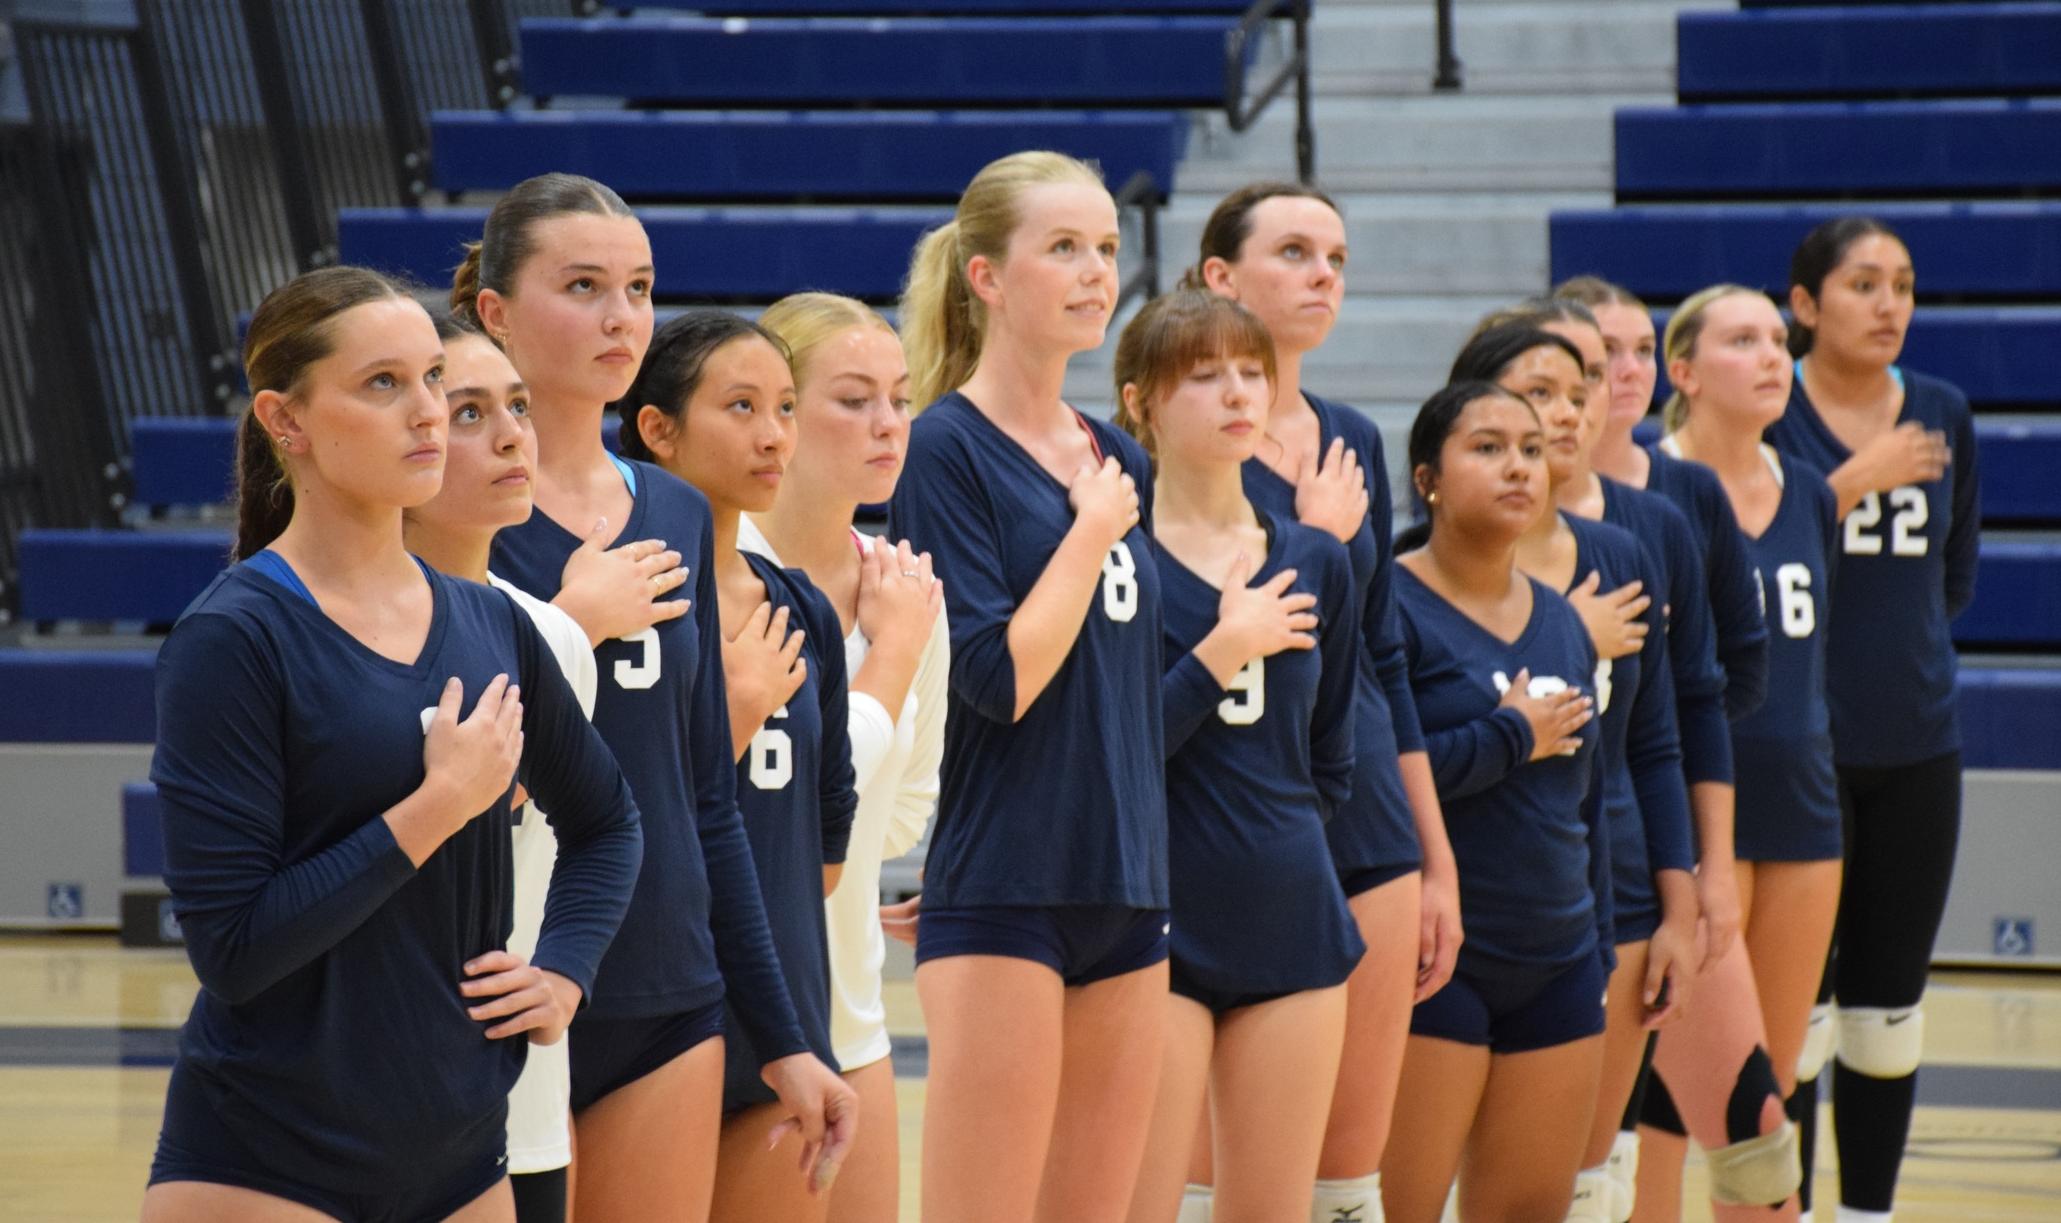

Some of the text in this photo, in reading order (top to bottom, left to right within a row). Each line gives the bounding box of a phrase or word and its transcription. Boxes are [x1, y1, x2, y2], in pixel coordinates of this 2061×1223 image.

[1843, 486, 1928, 555] 22
[1102, 539, 1138, 622] 8
[1217, 655, 1265, 725] 9
[748, 704, 793, 790] 6
